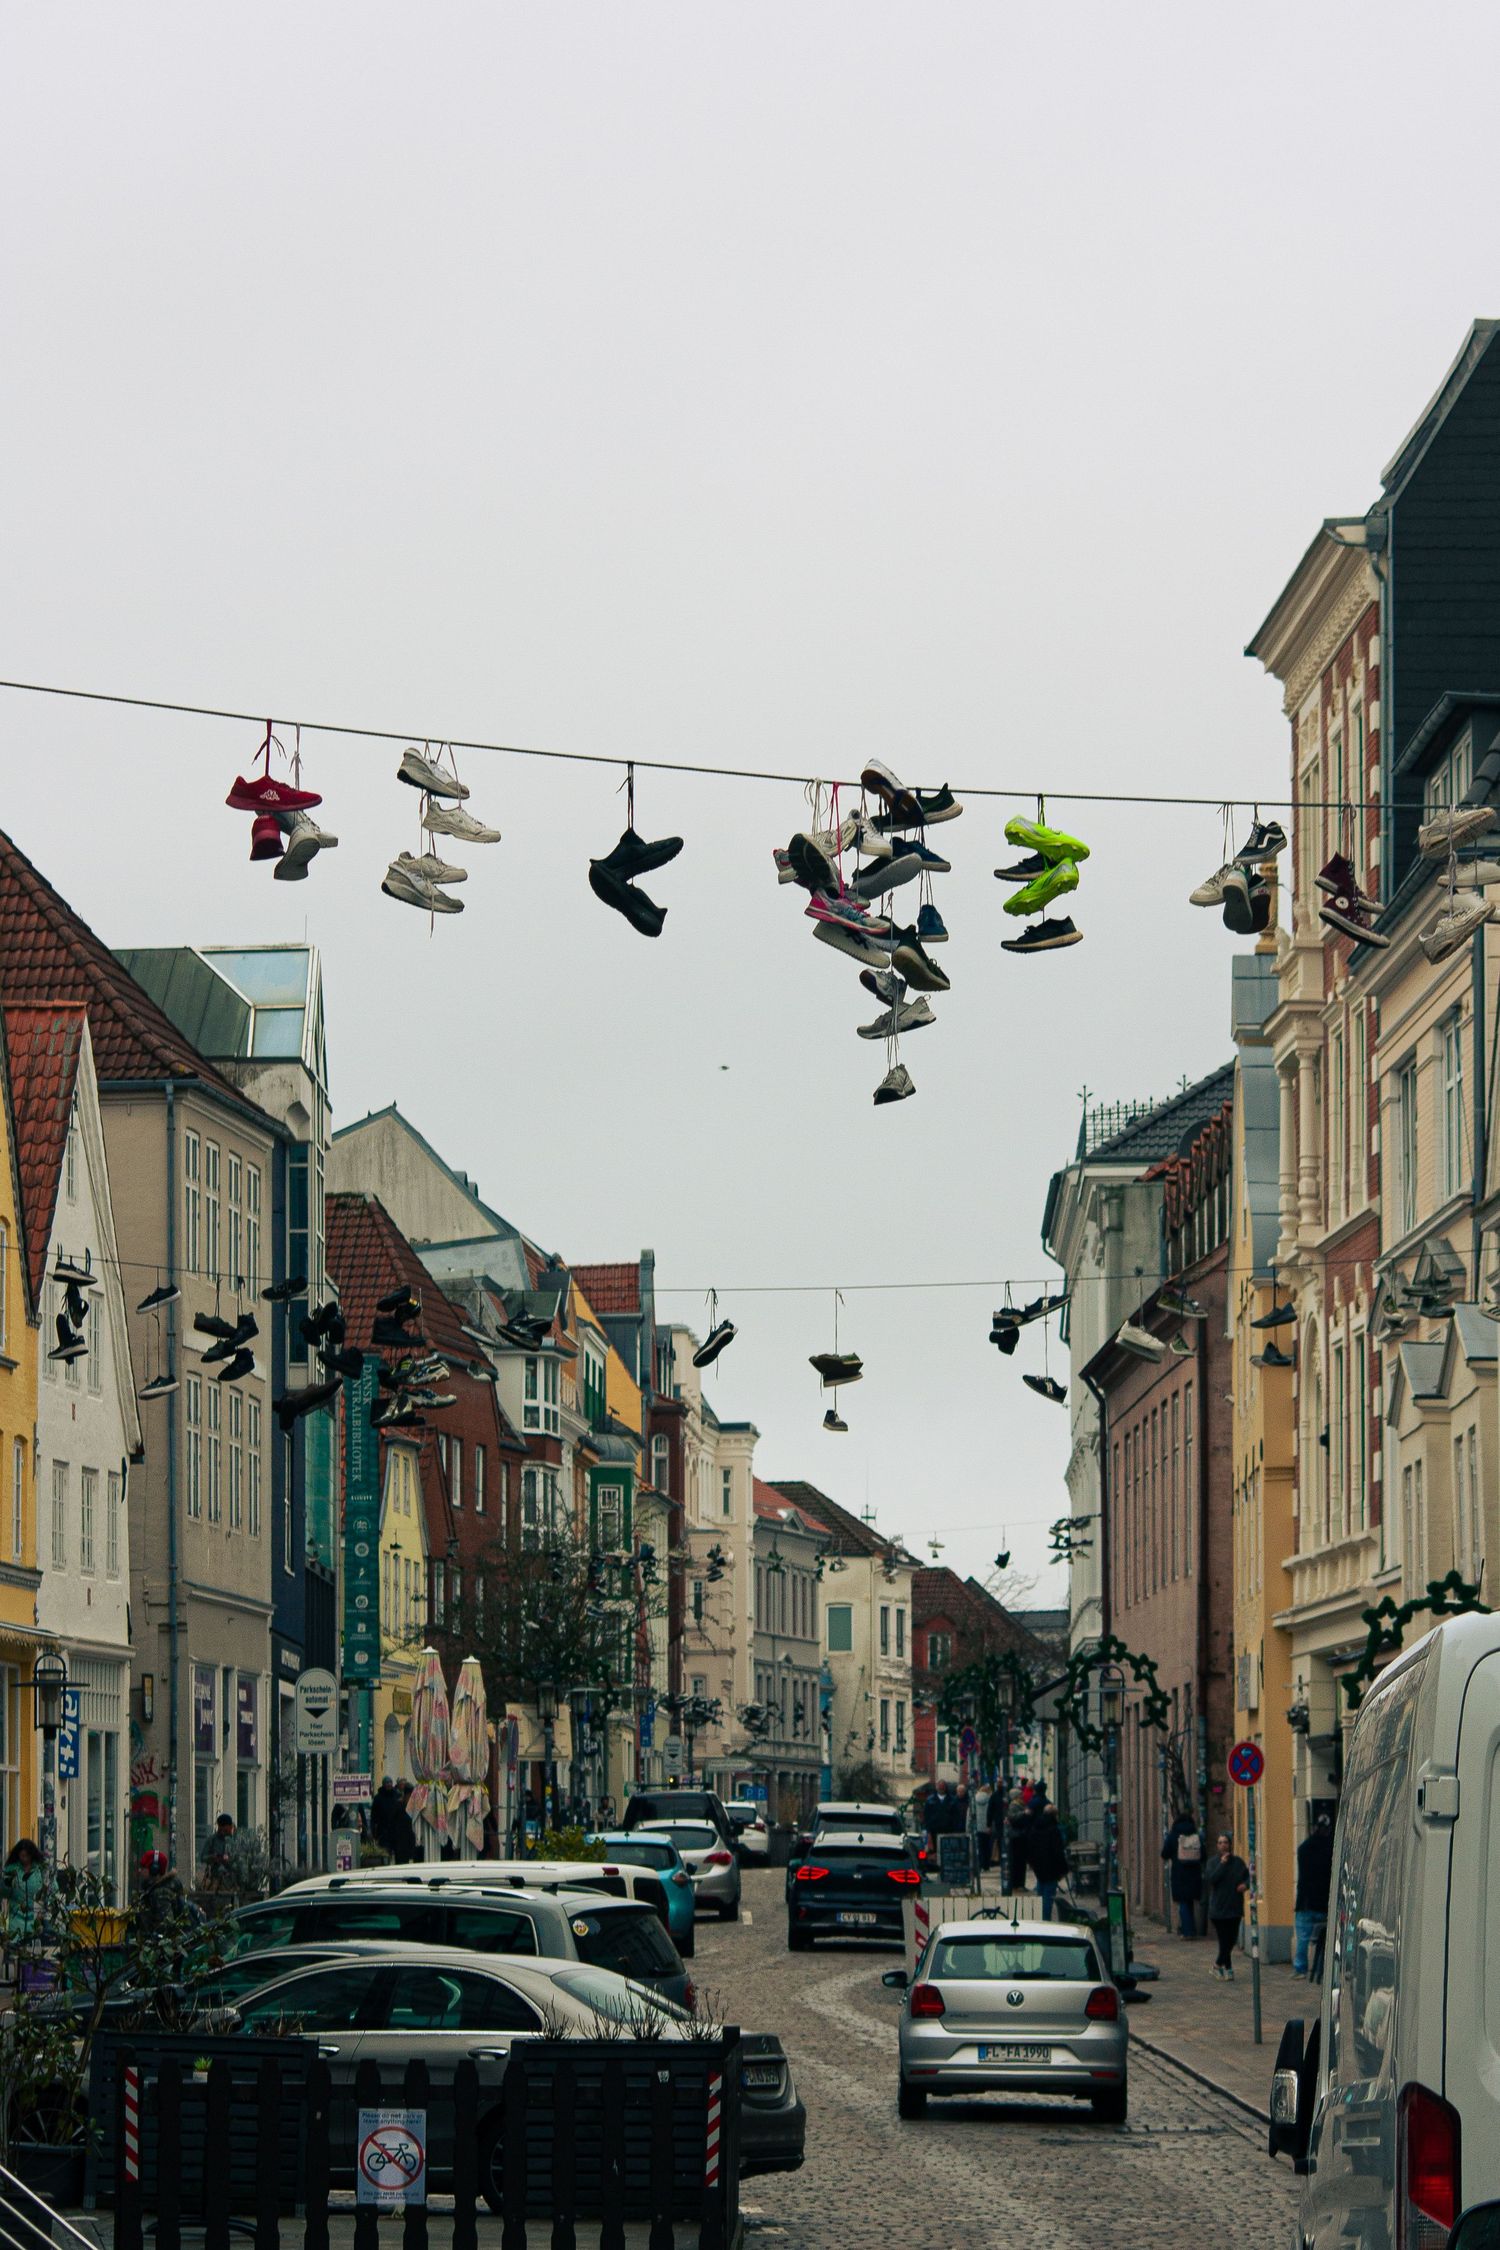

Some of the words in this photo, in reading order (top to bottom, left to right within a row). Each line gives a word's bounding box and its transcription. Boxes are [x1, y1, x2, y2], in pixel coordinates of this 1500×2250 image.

[362, 1364, 373, 1404] DANSK
[351, 1379, 362, 1482] NTRALBIBLIOTEK
[299, 1685, 333, 1694] Parkschein-
[305, 1695, 328, 1704] automat
[308, 1738, 326, 1746] lösen
[986, 2046, 999, 2057] FL
[1007, 2046, 1020, 2057] FA
[1023, 2046, 1049, 2057] 1990
